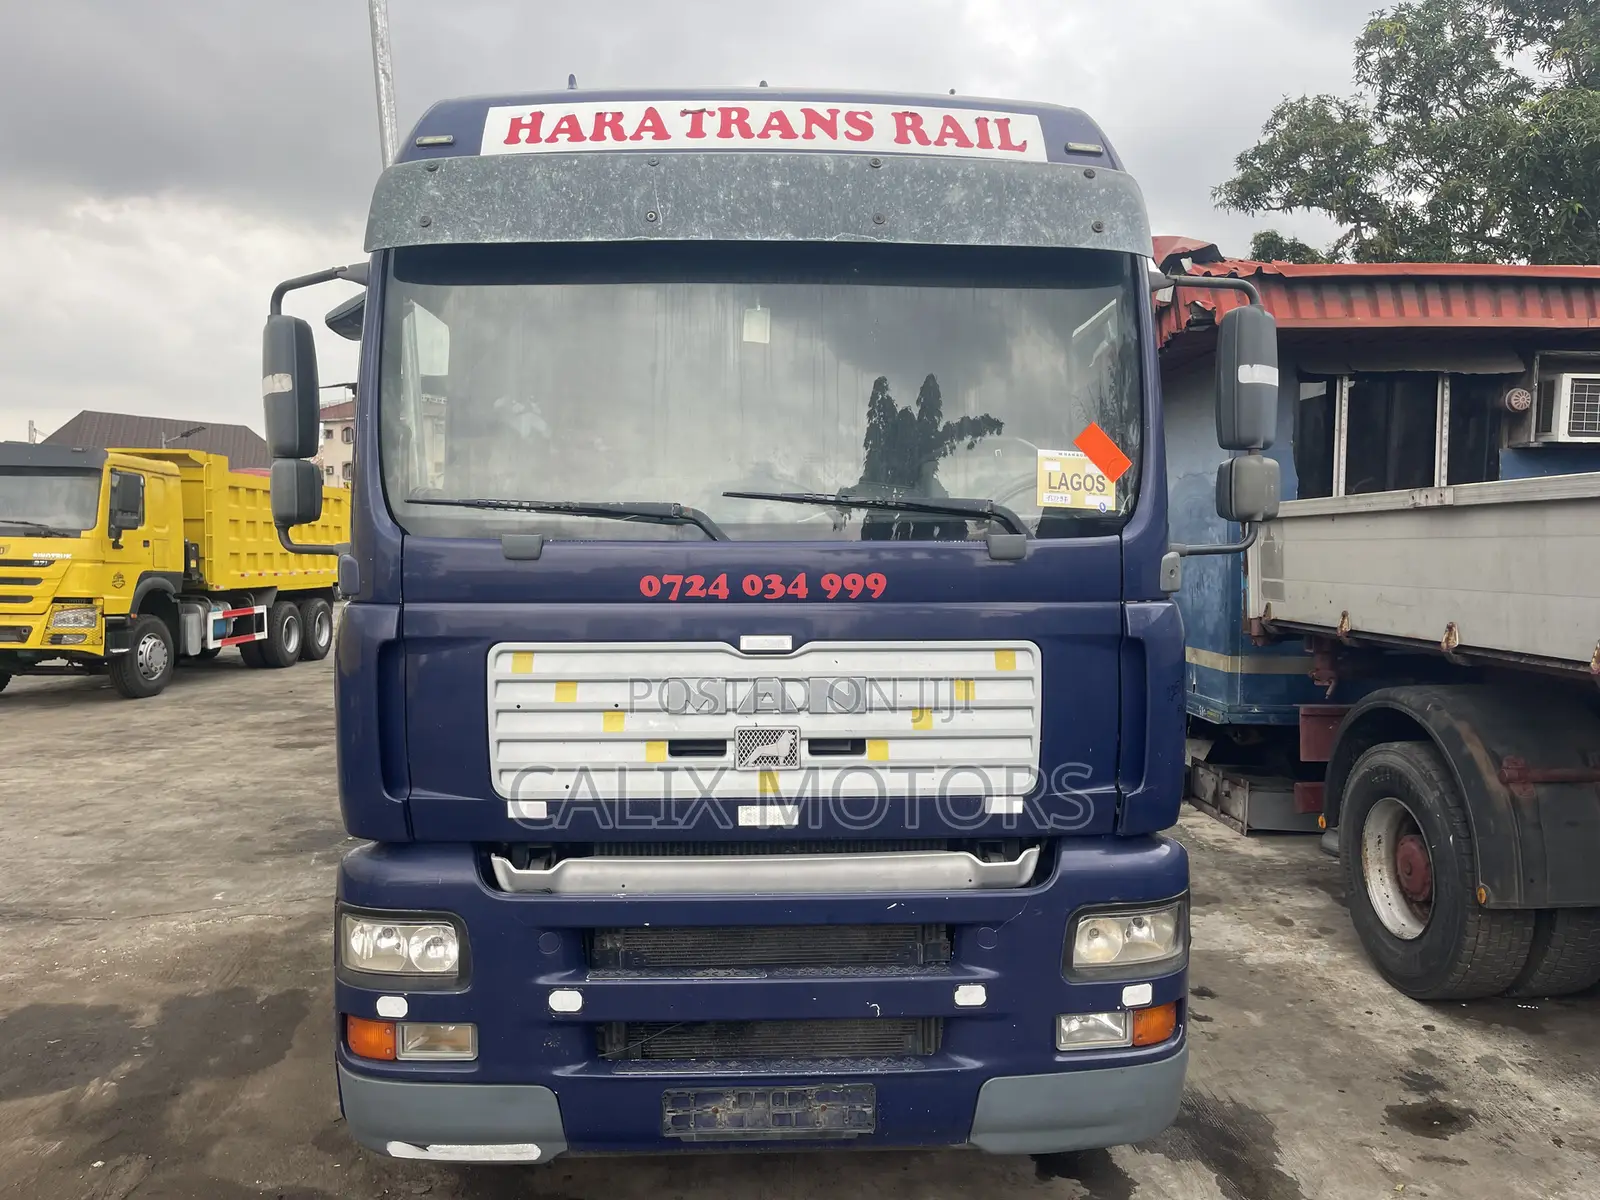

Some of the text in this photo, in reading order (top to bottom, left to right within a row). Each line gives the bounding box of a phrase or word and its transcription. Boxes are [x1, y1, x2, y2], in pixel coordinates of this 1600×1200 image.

[503, 106, 1028, 153] HARA TRANS RAIL
[1048, 471, 1106, 493] LAGOS
[639, 572, 888, 601] 0724 034 999
[667, 677, 868, 715] MAN
